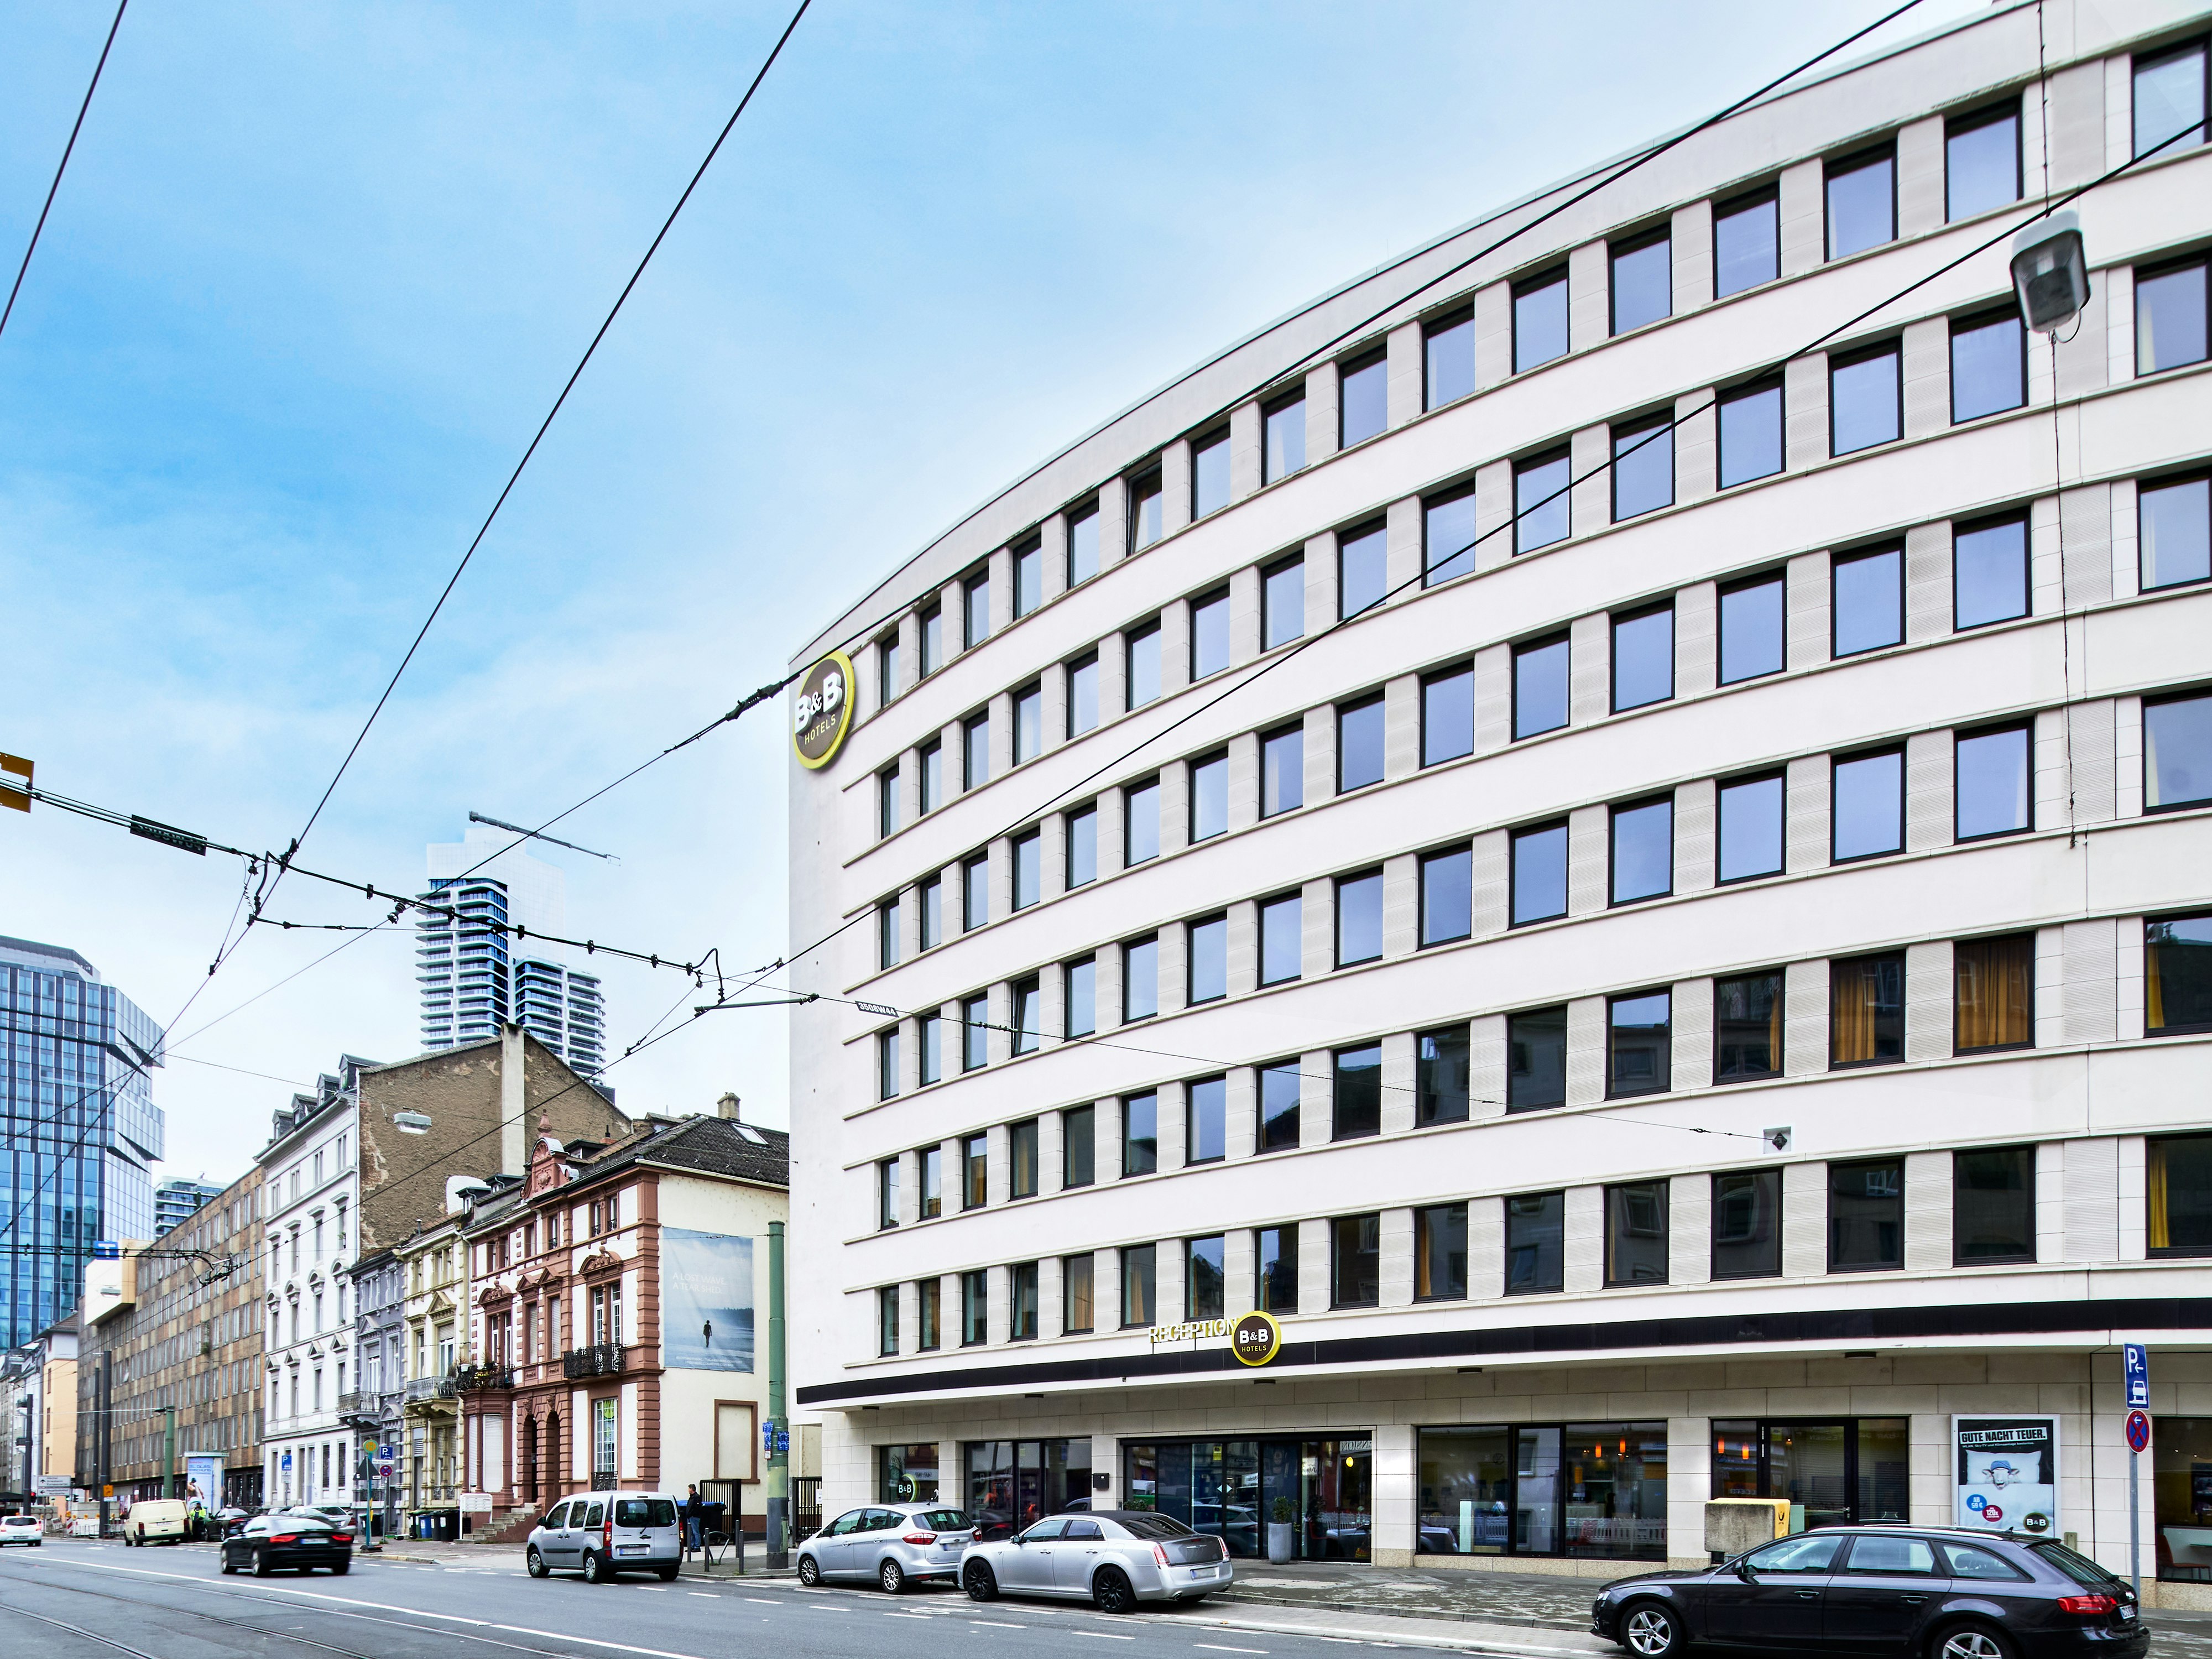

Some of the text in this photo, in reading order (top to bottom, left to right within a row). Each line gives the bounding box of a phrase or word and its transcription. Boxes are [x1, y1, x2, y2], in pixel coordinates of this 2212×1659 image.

[795, 672, 843, 734] B&B
[805, 714, 836, 745] HOTELS
[858, 1002, 896, 1015] 3508W44
[680, 1273, 700, 1282] LOST
[681, 1283, 700, 1292] TEAR
[1149, 1318, 1237, 1343] RECEPTION
[1239, 1328, 1269, 1344] B&B
[2127, 1348, 2138, 1373] P
[1961, 1429, 2046, 1442] GUTE NACHT TEUER.
[899, 1484, 912, 1494] B&B
